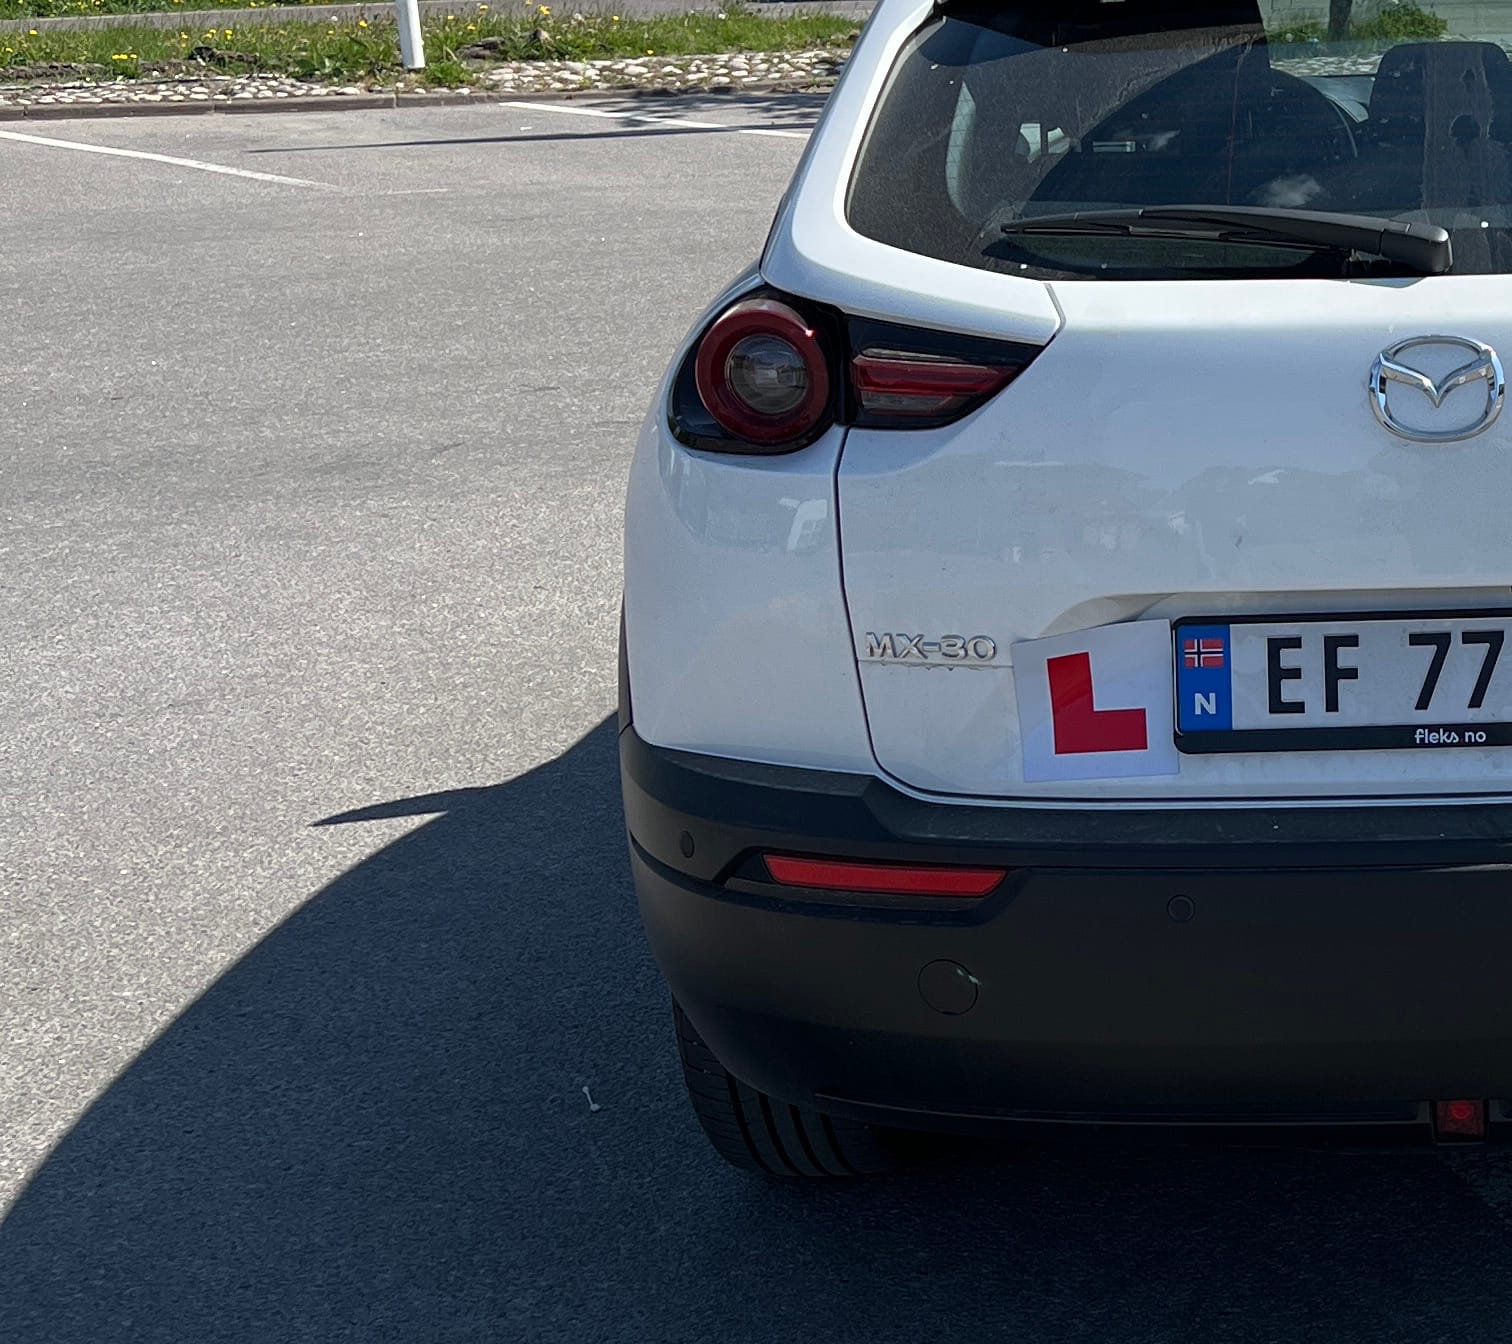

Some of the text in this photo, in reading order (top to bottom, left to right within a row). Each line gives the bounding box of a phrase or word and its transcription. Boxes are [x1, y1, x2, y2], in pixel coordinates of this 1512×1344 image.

[864, 631, 998, 661] MX-30
[1266, 633, 1360, 715] EF
[1046, 651, 1148, 755] L
[1194, 691, 1217, 716] N
